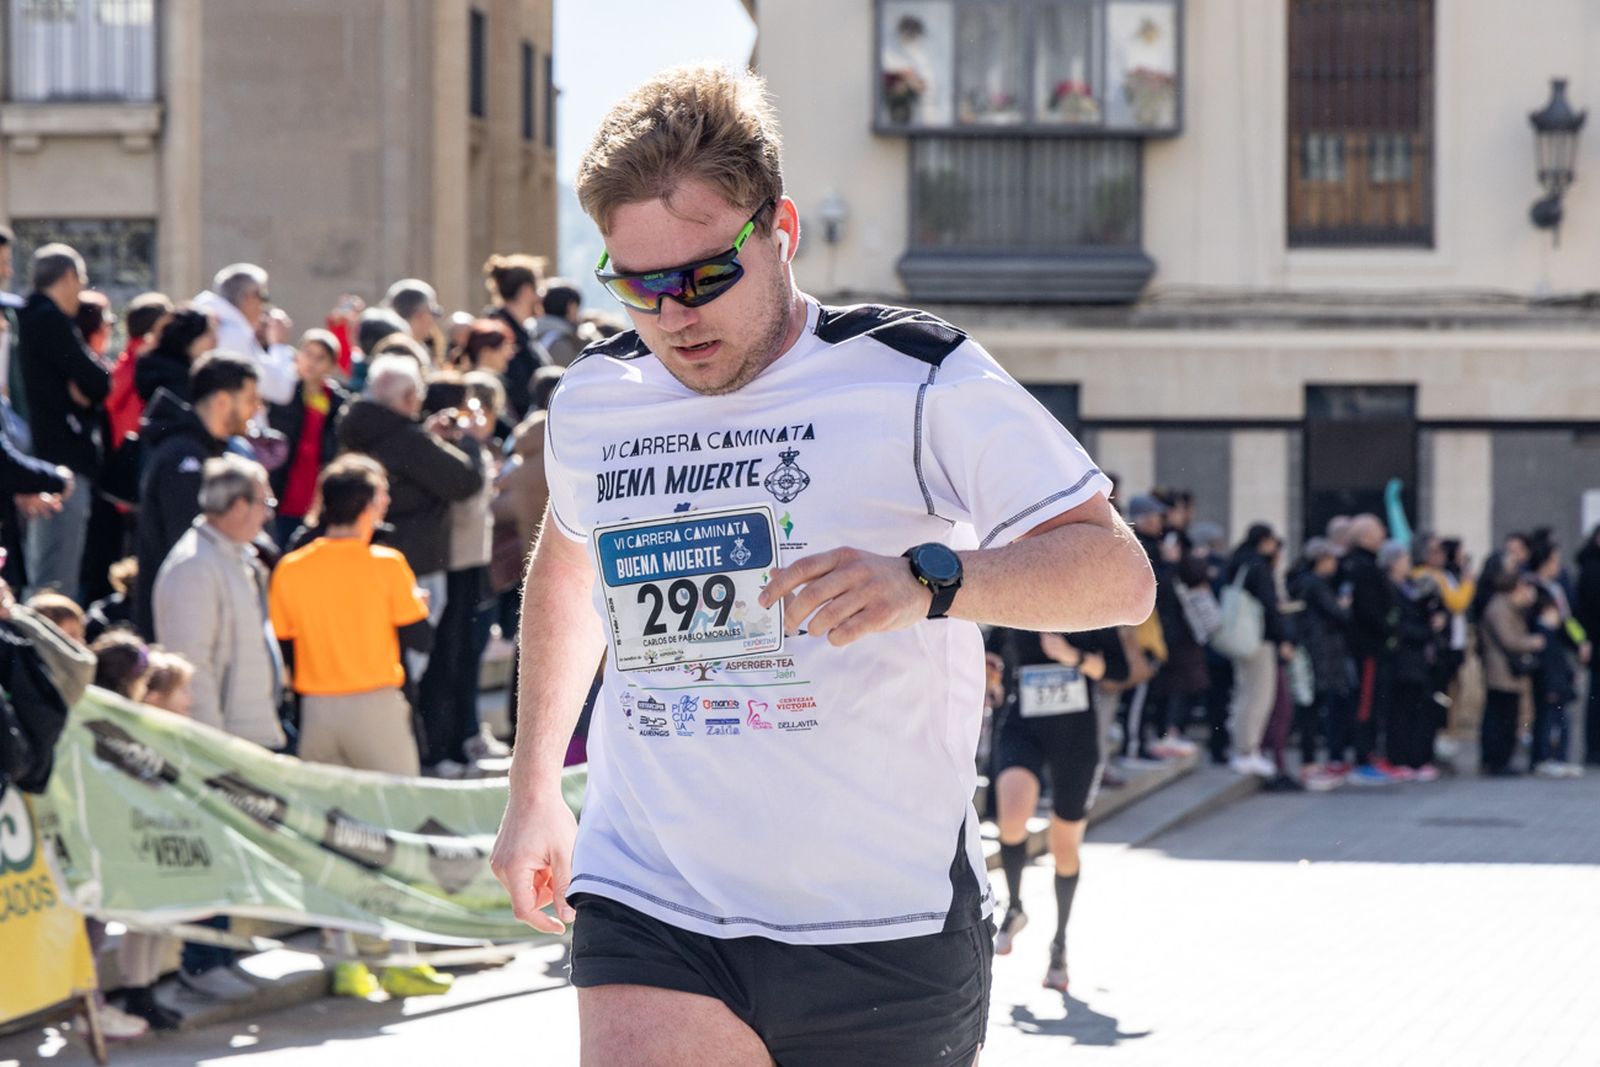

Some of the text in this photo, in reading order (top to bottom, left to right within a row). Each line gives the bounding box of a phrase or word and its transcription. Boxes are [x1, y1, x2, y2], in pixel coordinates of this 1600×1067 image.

[602, 422, 815, 462] VI CARRERA CAMINATA
[596, 458, 762, 504] BUENA MUERTE
[613, 520, 751, 551] VI CARRERA CAMINATA
[616, 545, 723, 580] BUENA MUERTE
[636, 574, 737, 637] 299
[643, 627, 742, 648] CARLOS DE PABLO MORALES
[725, 658, 795, 671] ASPERGER-TEA
[773, 668, 796, 679] Jaén
[776, 702, 817, 710] VICTORIA
[779, 696, 814, 704] CERVEZAS
[777, 720, 819, 729] DELLAVITA
